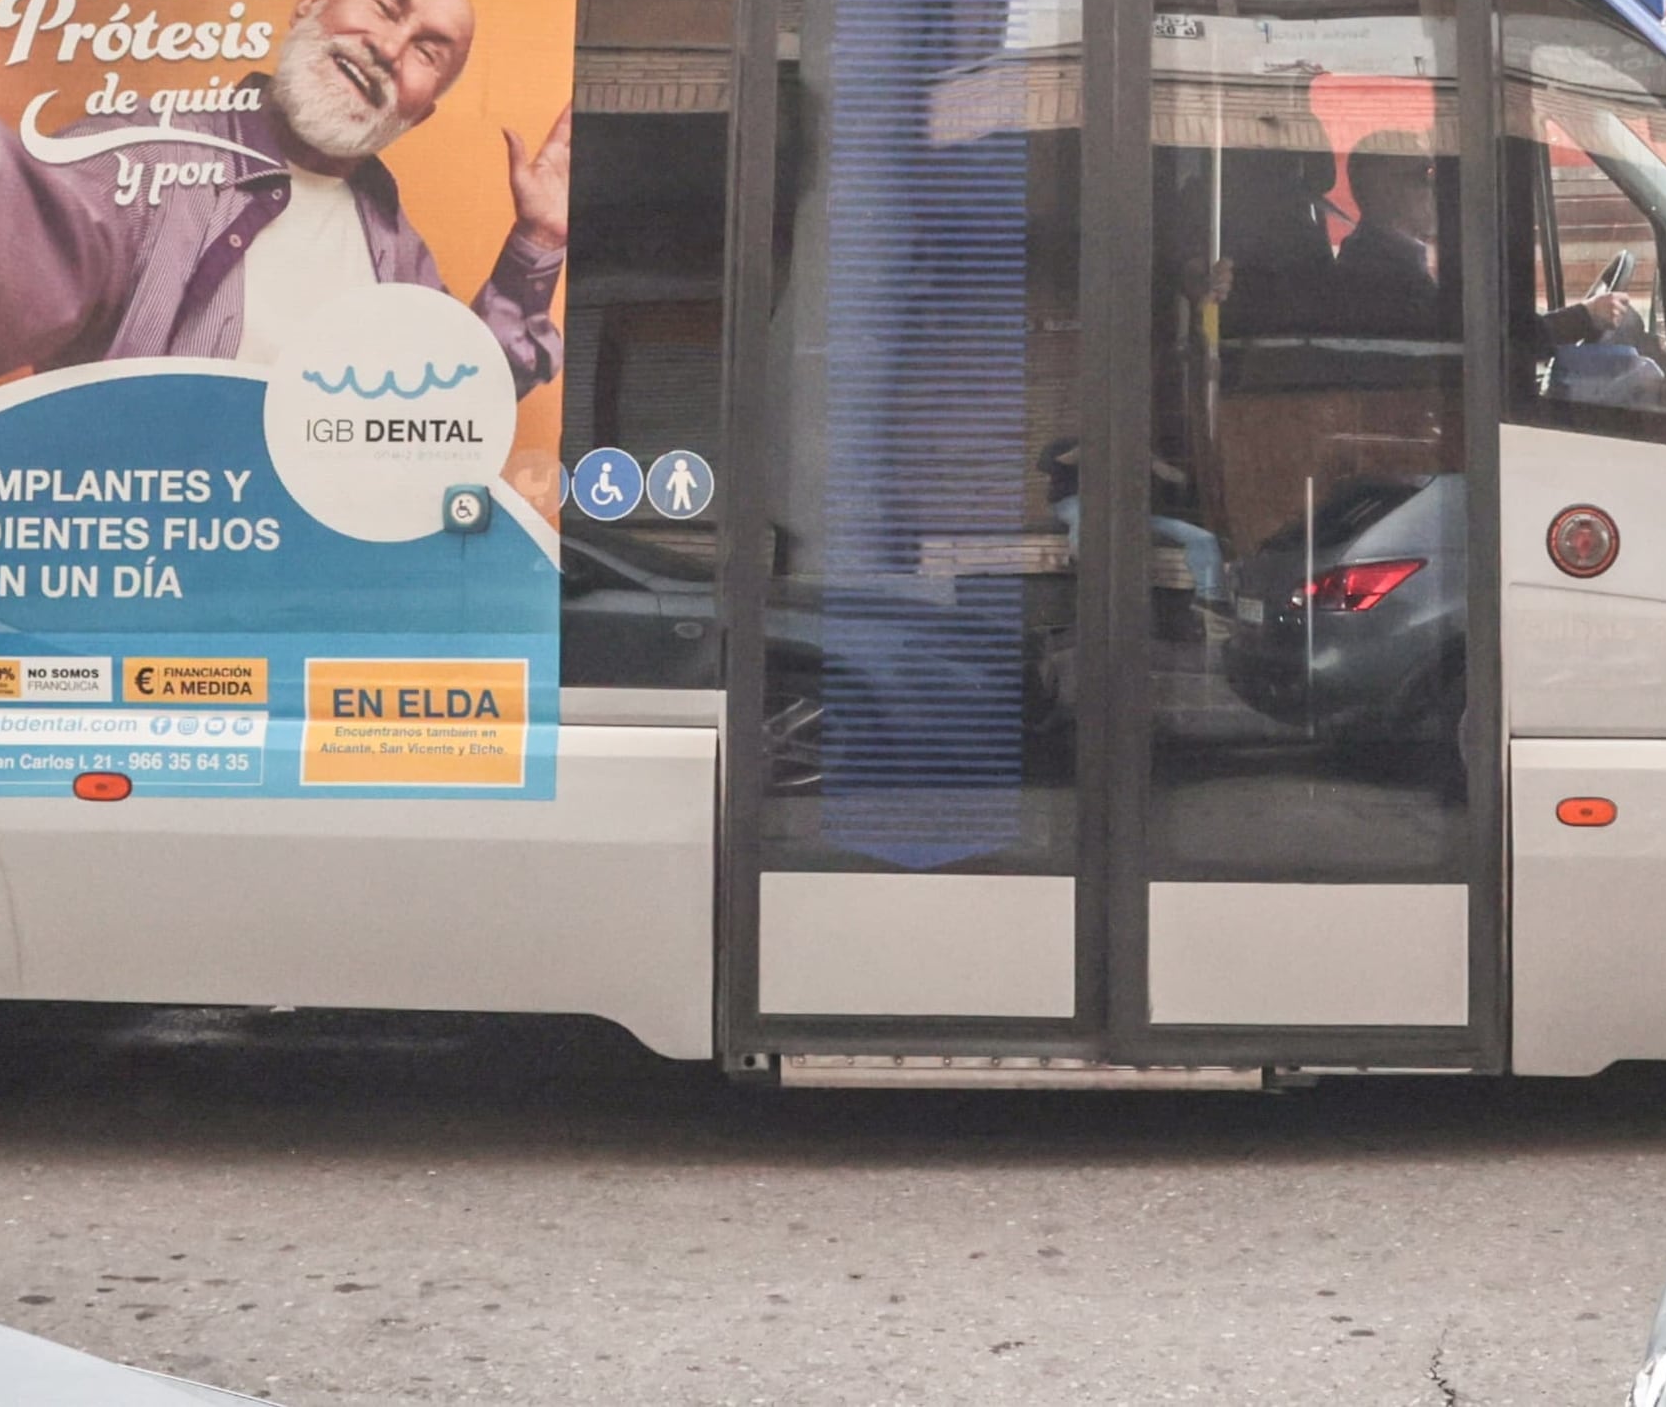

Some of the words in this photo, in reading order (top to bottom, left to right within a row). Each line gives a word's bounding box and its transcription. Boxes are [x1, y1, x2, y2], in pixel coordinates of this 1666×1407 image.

[85, 72, 139, 115] de
[149, 76, 262, 130] quita
[148, 161, 227, 206] pon
[306, 419, 354, 443] IGB
[365, 419, 483, 443] DENTAL
[223, 470, 251, 503] Y
[163, 517, 281, 551] FIJOS
[40, 565, 98, 598] UN
[113, 556, 183, 598] DÍA
[27, 668, 47, 679] NO
[51, 668, 100, 679] SOMOS
[163, 665, 253, 679] FINANCIACIÓN
[27, 680, 100, 691] FRANQUICIA
[162, 681, 175, 695] A
[180, 681, 253, 695] MEDIDA
[333, 688, 383, 719] EN
[398, 688, 500, 719] ELDA
[426, 726, 478, 738] también
[481, 729, 497, 738] en
[320, 742, 376, 755] Alicante,
[379, 742, 403, 754] San
[408, 742, 454, 754] Vicente
[458, 745, 465, 756] y
[19, 754, 75, 770] Carlos
[93, 754, 112, 770] 21
[128, 752, 164, 771] 966
[168, 753, 191, 771] 35
[196, 753, 220, 771] 64
[225, 753, 250, 771] 35
